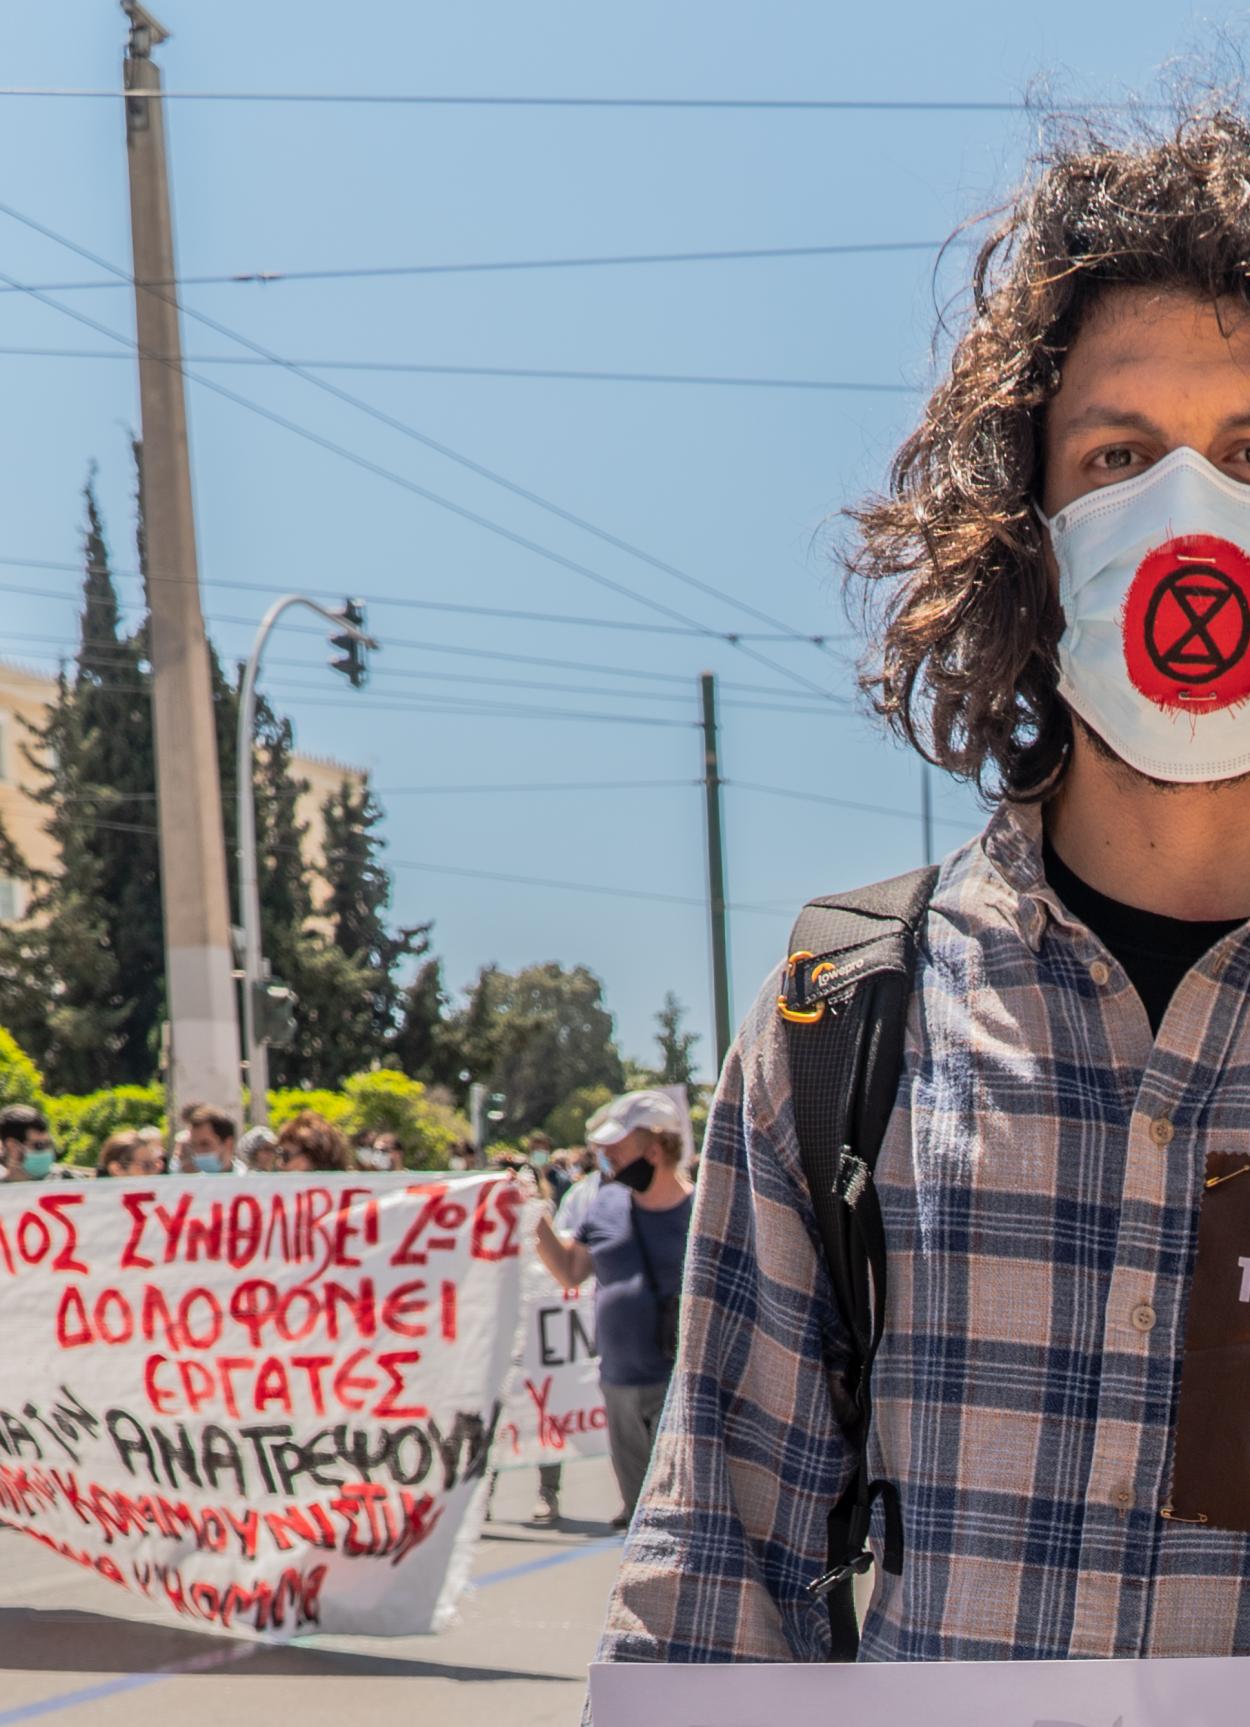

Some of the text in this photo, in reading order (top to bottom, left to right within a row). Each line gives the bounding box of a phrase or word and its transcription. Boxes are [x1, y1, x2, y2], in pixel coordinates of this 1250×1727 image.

[818, 958, 865, 988] Lowepro
[121, 1187, 379, 1283] ΣΥΝΘΛΙΒΕΙ
[57, 1278, 456, 1351] ΔΟΛΟΦΟΝΕΙ
[145, 1348, 428, 1419] ΕΡΓΑΤΕΣ
